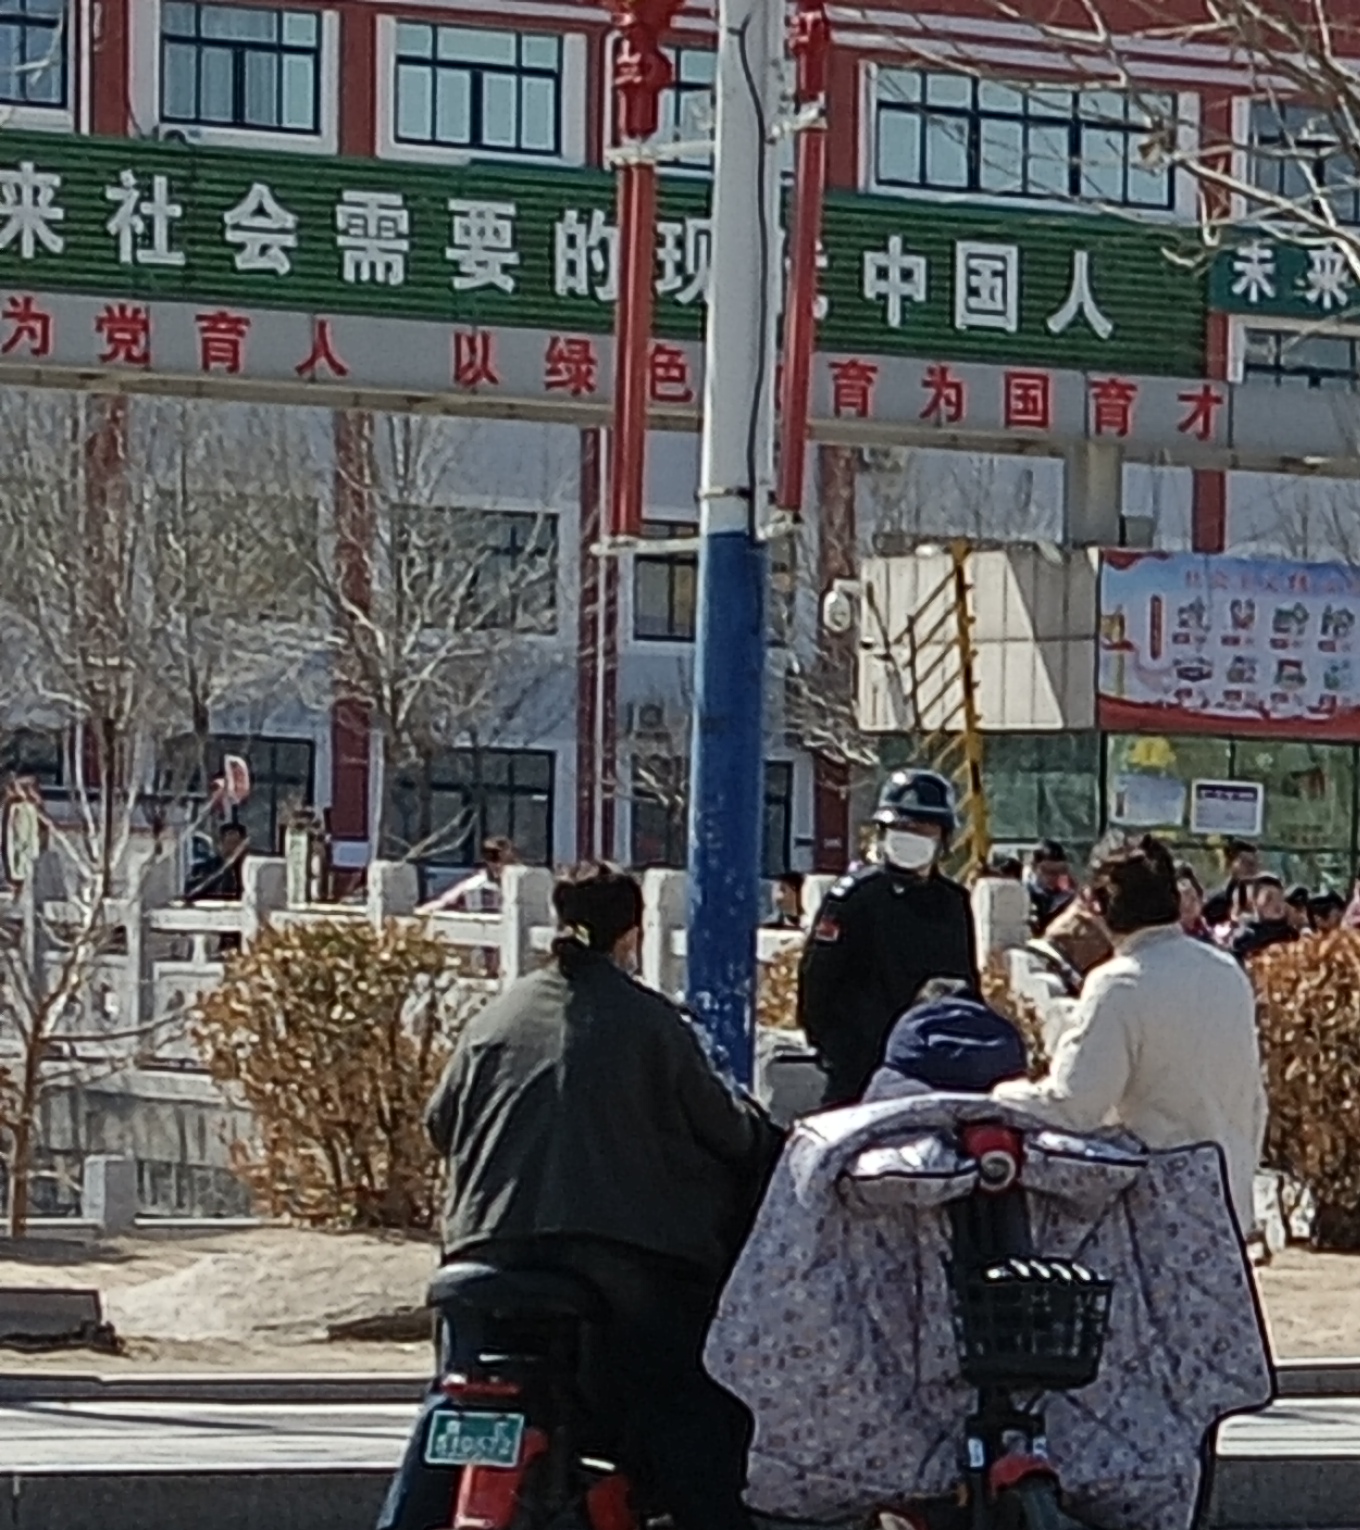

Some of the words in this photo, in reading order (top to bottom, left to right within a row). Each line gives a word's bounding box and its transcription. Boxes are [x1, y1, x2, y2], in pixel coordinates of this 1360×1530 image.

[0, 162, 1115, 341] 来社会需要的现中国人
[1, 297, 349, 379] 为党育人
[453, 329, 1225, 439] 以绿色育为国育才
